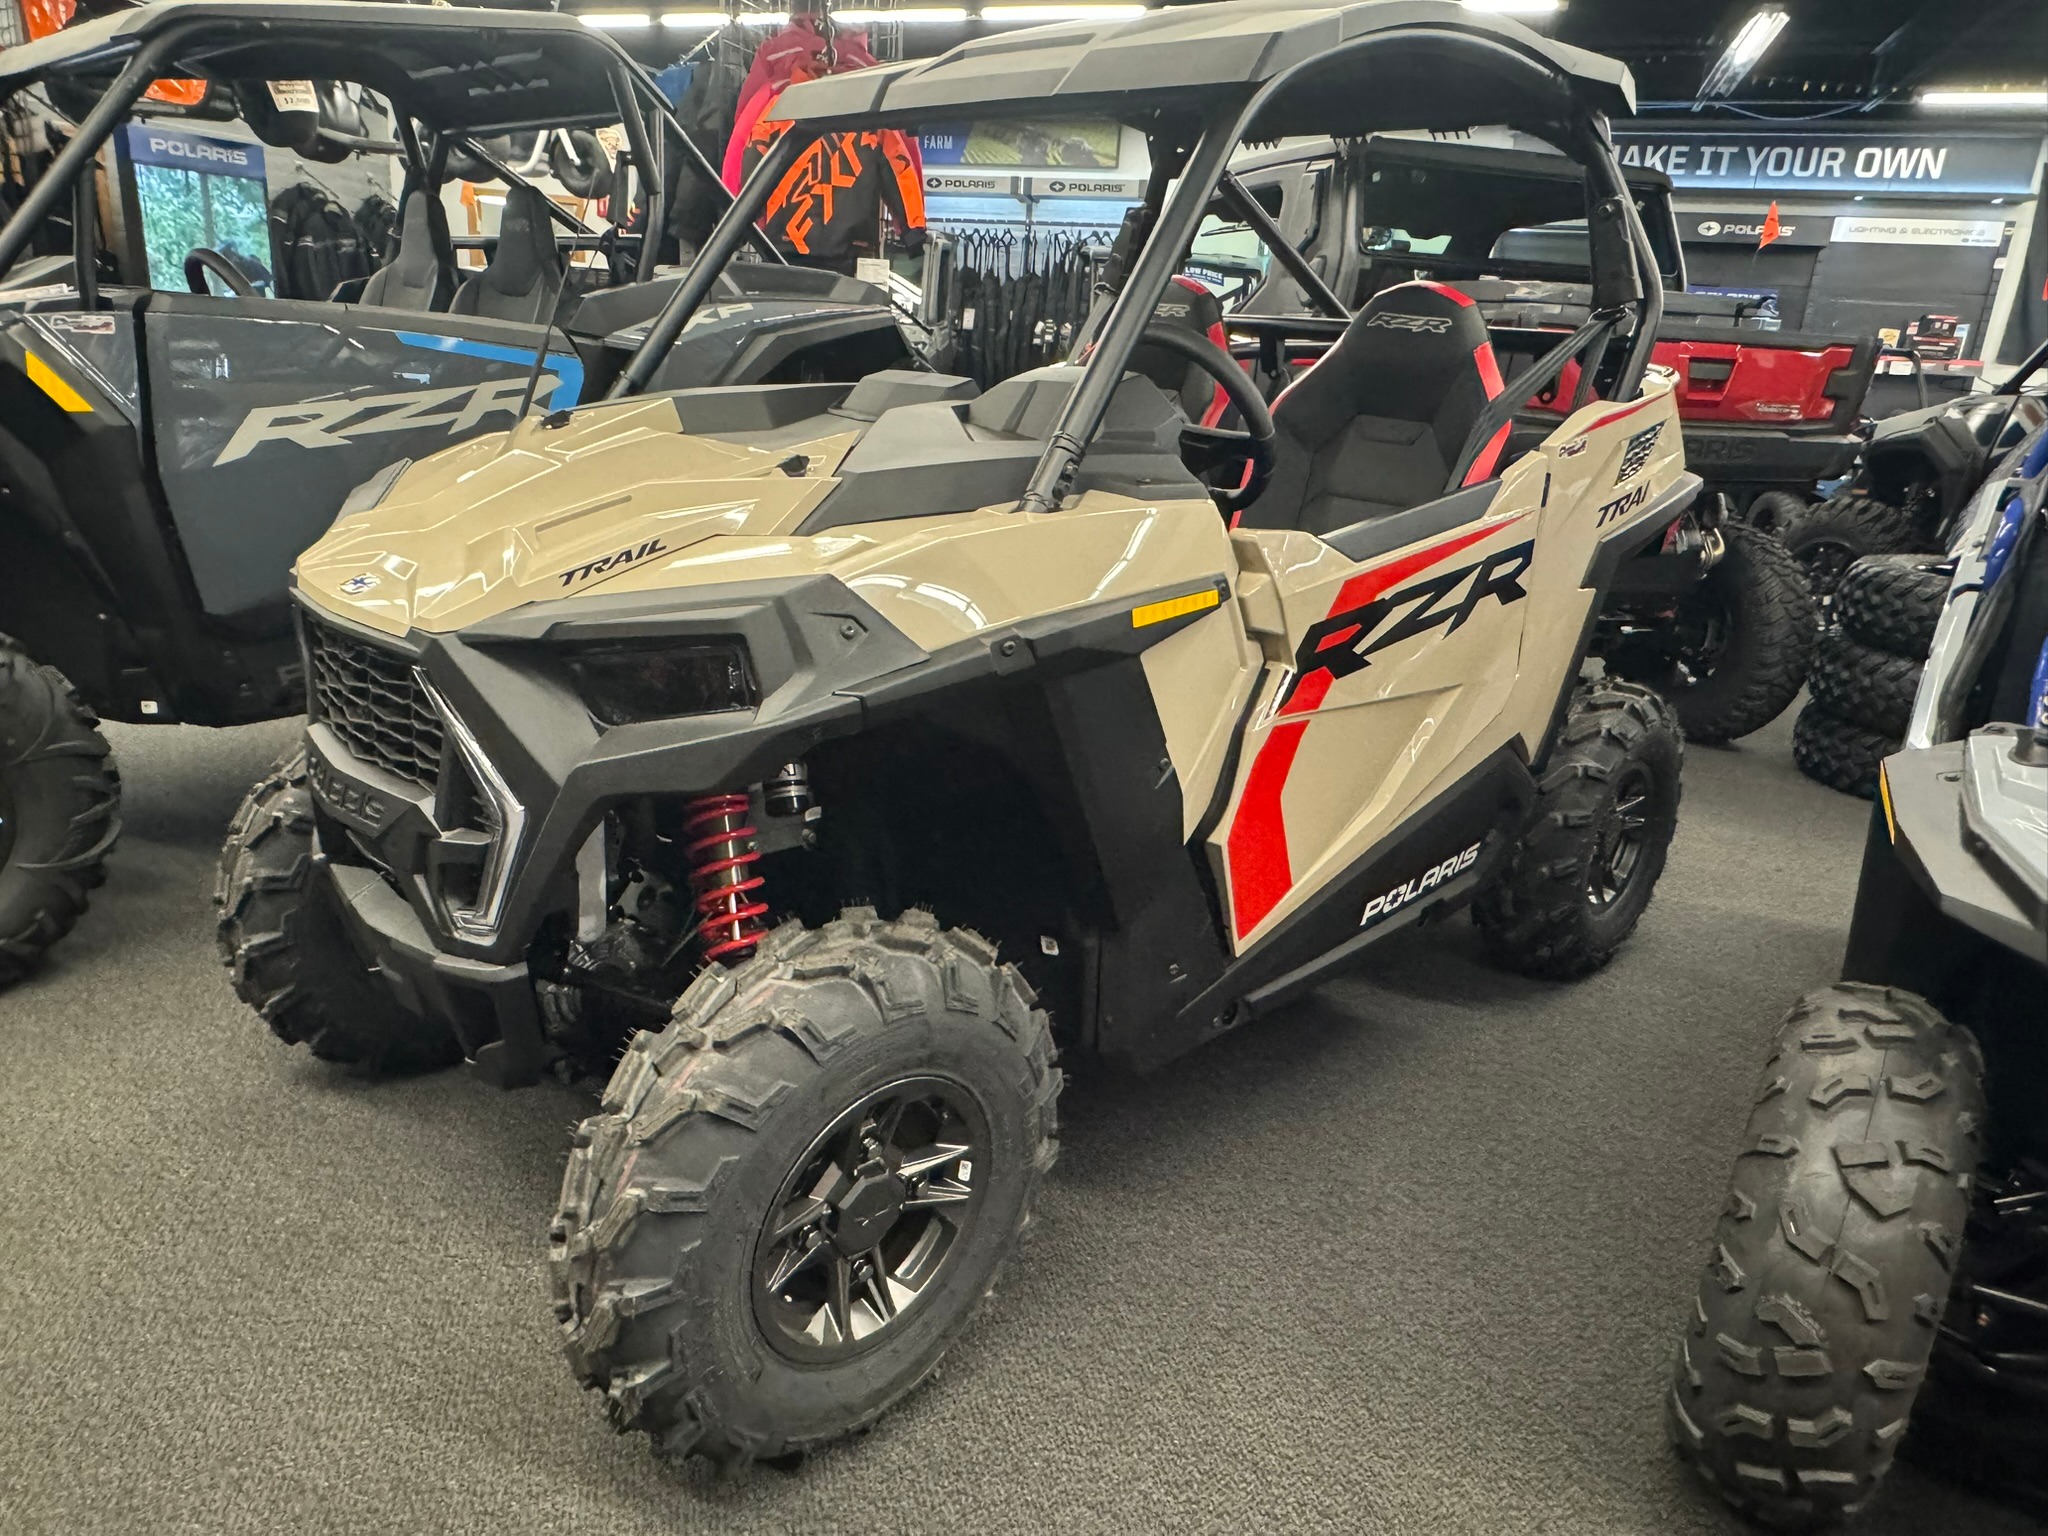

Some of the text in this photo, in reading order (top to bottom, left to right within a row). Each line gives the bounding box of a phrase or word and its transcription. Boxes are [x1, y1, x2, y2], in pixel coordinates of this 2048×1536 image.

[148, 137, 248, 166] POLARIS
[923, 135, 953, 150] FARM
[1611, 144, 1948, 179] AKE IT YOUR OWN
[944, 179, 996, 189] POLARIS
[1068, 183, 1125, 193] POLARIS
[1366, 311, 1452, 333] RZR
[212, 374, 562, 467] RZR
[558, 538, 667, 588] TRAIL
[1280, 537, 1536, 702] RZR
[1359, 841, 1482, 927] POLARIS
